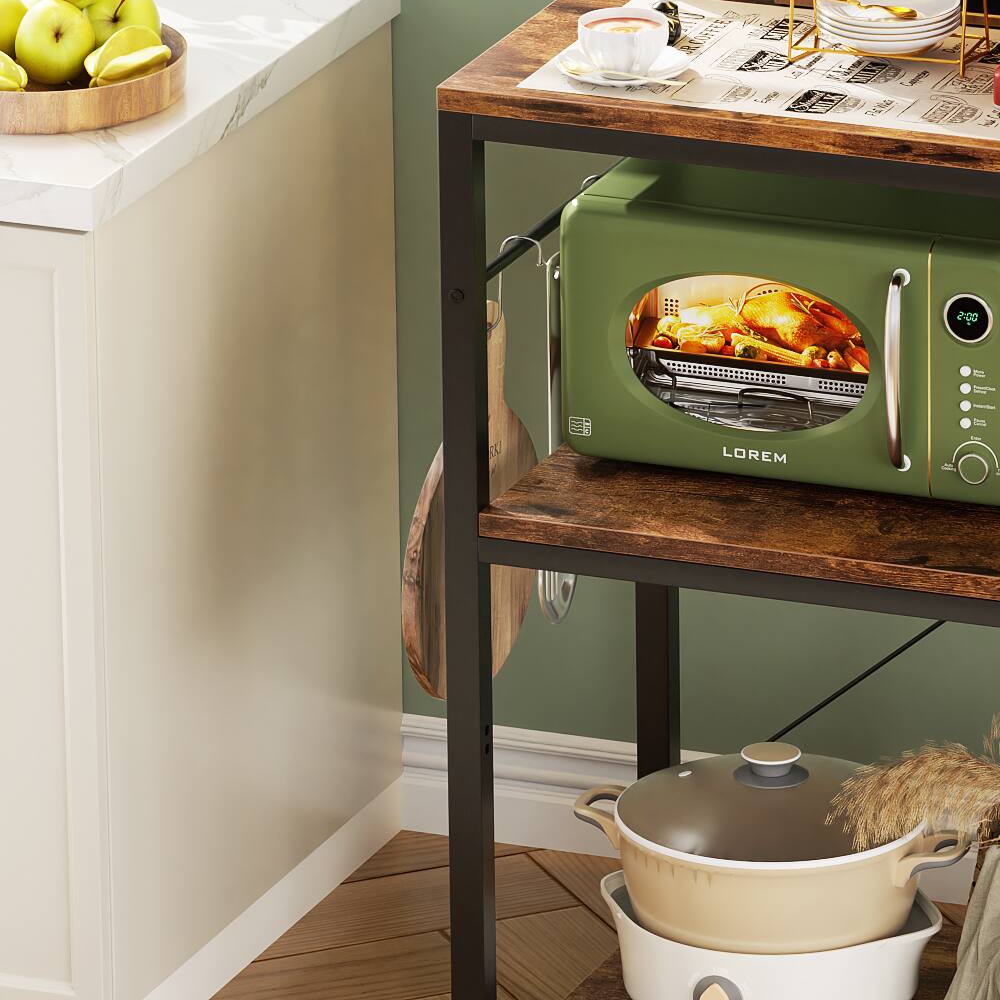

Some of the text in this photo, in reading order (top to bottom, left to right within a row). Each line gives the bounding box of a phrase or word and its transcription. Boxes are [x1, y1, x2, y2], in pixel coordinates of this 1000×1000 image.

[688, 18, 734, 45] COFFEE
[957, 311, 979, 322] 2:00
[723, 446, 788, 464] LOREM
